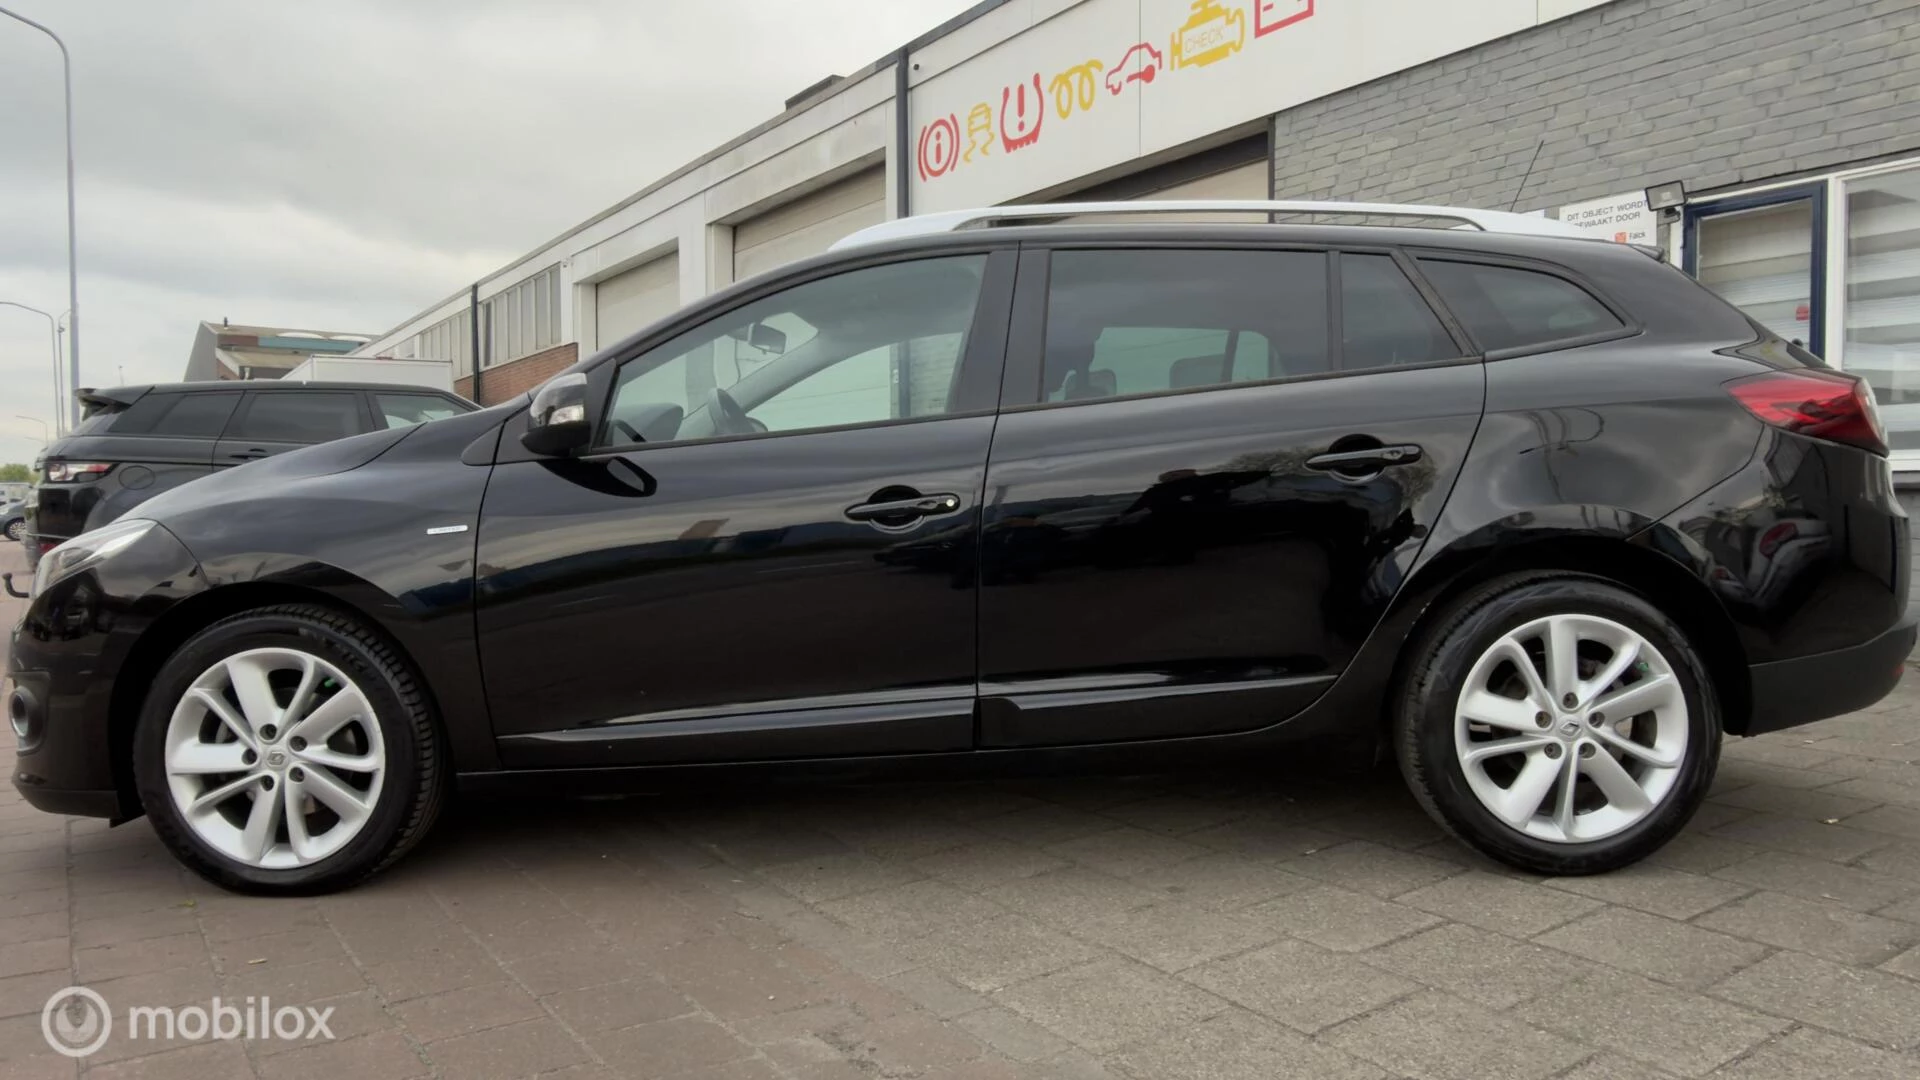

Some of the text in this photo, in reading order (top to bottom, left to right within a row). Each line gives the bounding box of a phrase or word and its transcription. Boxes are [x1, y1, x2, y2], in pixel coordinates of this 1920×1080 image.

[1184, 25, 1224, 53] CHECK
[1567, 212, 1580, 222] DIT
[1582, 206, 1613, 219] OBJECT
[1573, 211, 1641, 229] EWAAKT DOOR
